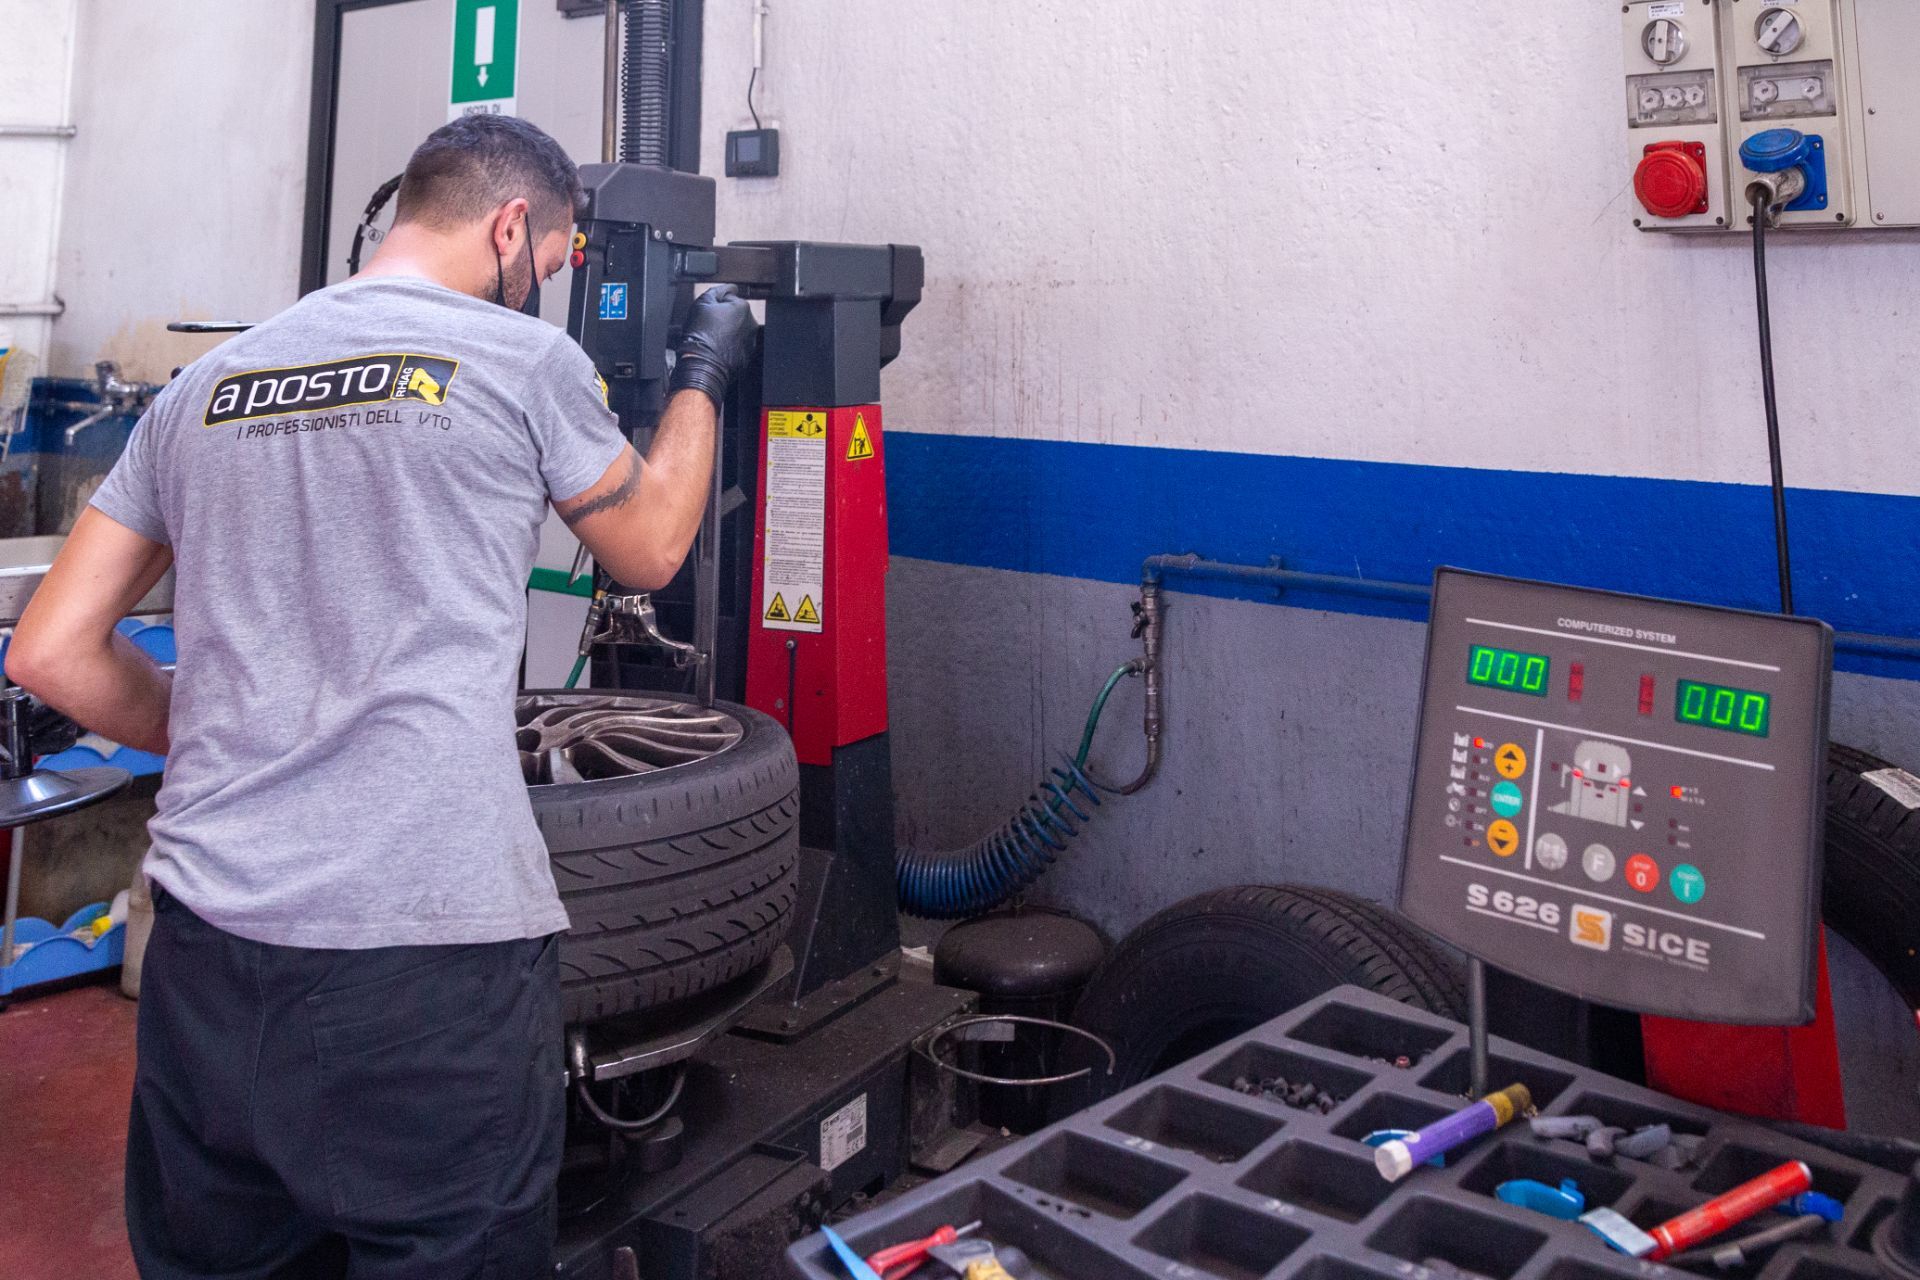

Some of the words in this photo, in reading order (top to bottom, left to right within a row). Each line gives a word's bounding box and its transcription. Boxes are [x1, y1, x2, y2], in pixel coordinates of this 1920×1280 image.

[395, 367, 414, 398] RHIAG
[246, 413, 360, 439] PROFESSIONISTI
[1557, 617, 1634, 639] COMPUTERIZED
[1635, 628, 1676, 644] SYSTEM
[1472, 649, 1545, 691] 000
[1682, 685, 1765, 731] 000
[1592, 854, 1605, 872] F
[1467, 883, 1489, 907] S
[1492, 890, 1561, 926] 626
[1622, 922, 1712, 966] SICE
